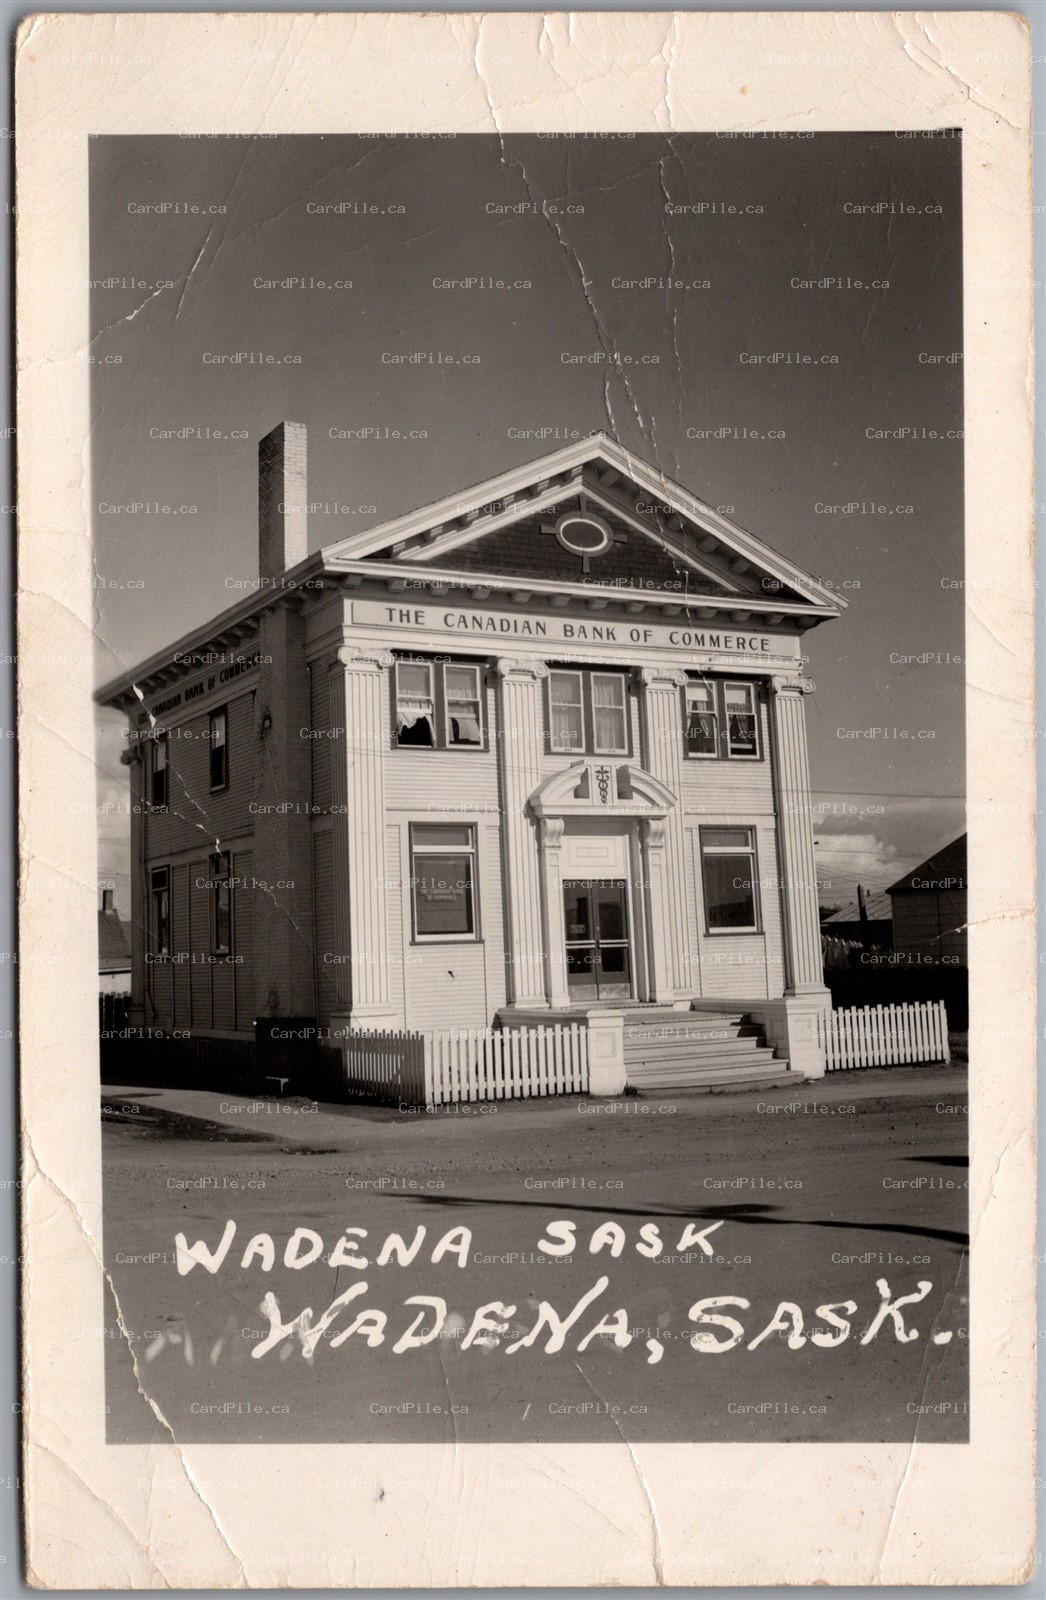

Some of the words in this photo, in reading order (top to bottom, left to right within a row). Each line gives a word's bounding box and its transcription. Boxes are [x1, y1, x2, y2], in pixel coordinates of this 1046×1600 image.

[385, 607, 425, 625] THE
[443, 613, 547, 636] CANADIAN
[563, 623, 617, 641] BANK
[630, 628, 653, 643] OF
[669, 631, 771, 651] COMMERCE
[185, 682, 204, 701] BANK
[208, 676, 216, 690] OF
[174, 1219, 473, 1276] WADENA
[537, 1220, 725, 1257] SASK
[251, 1276, 665, 1364] WADENA,
[689, 1278, 953, 1353] SASK.
